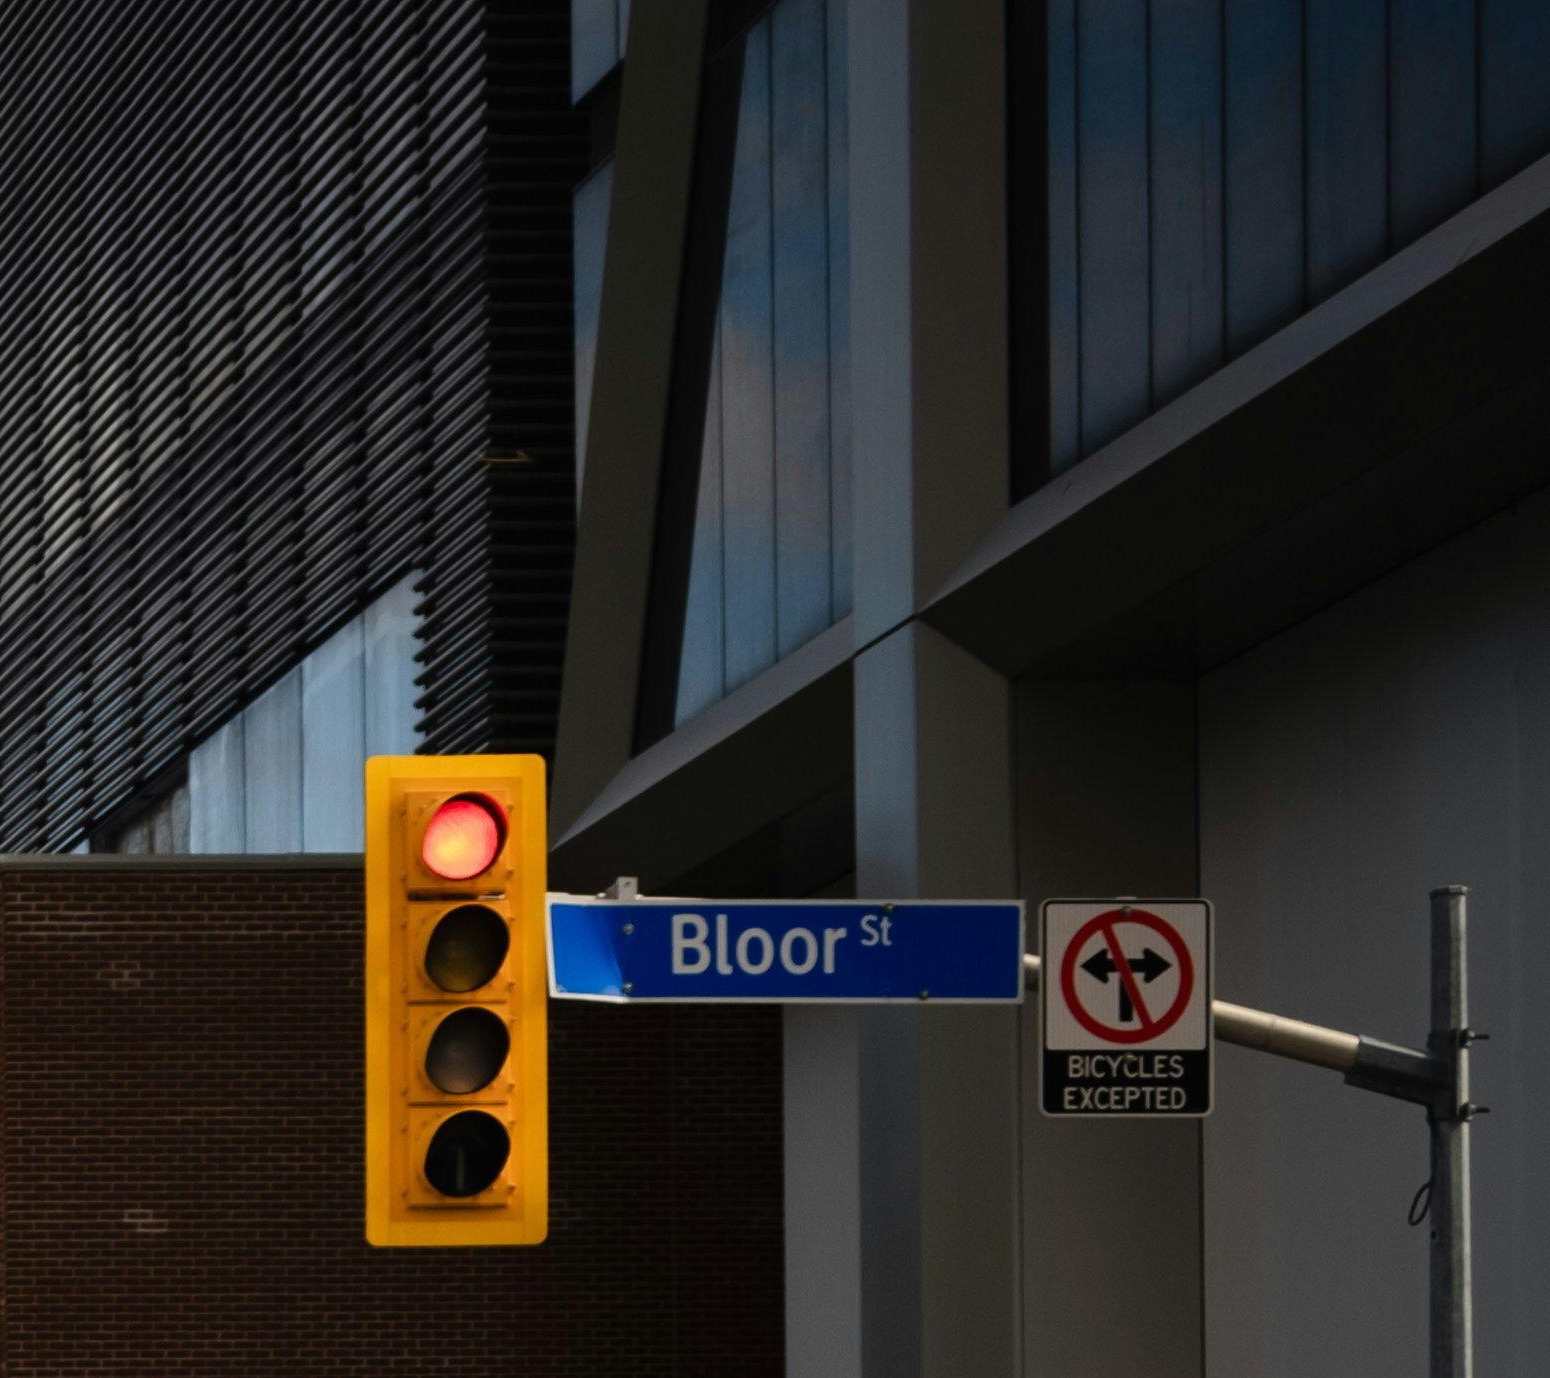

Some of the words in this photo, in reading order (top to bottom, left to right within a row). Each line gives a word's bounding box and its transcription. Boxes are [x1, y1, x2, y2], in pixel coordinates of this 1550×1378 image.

[671, 912, 847, 978] Bloor
[859, 914, 892, 947] St
[1067, 1054, 1184, 1081] BICYCLES
[1062, 1086, 1187, 1111] EXCEPTED
